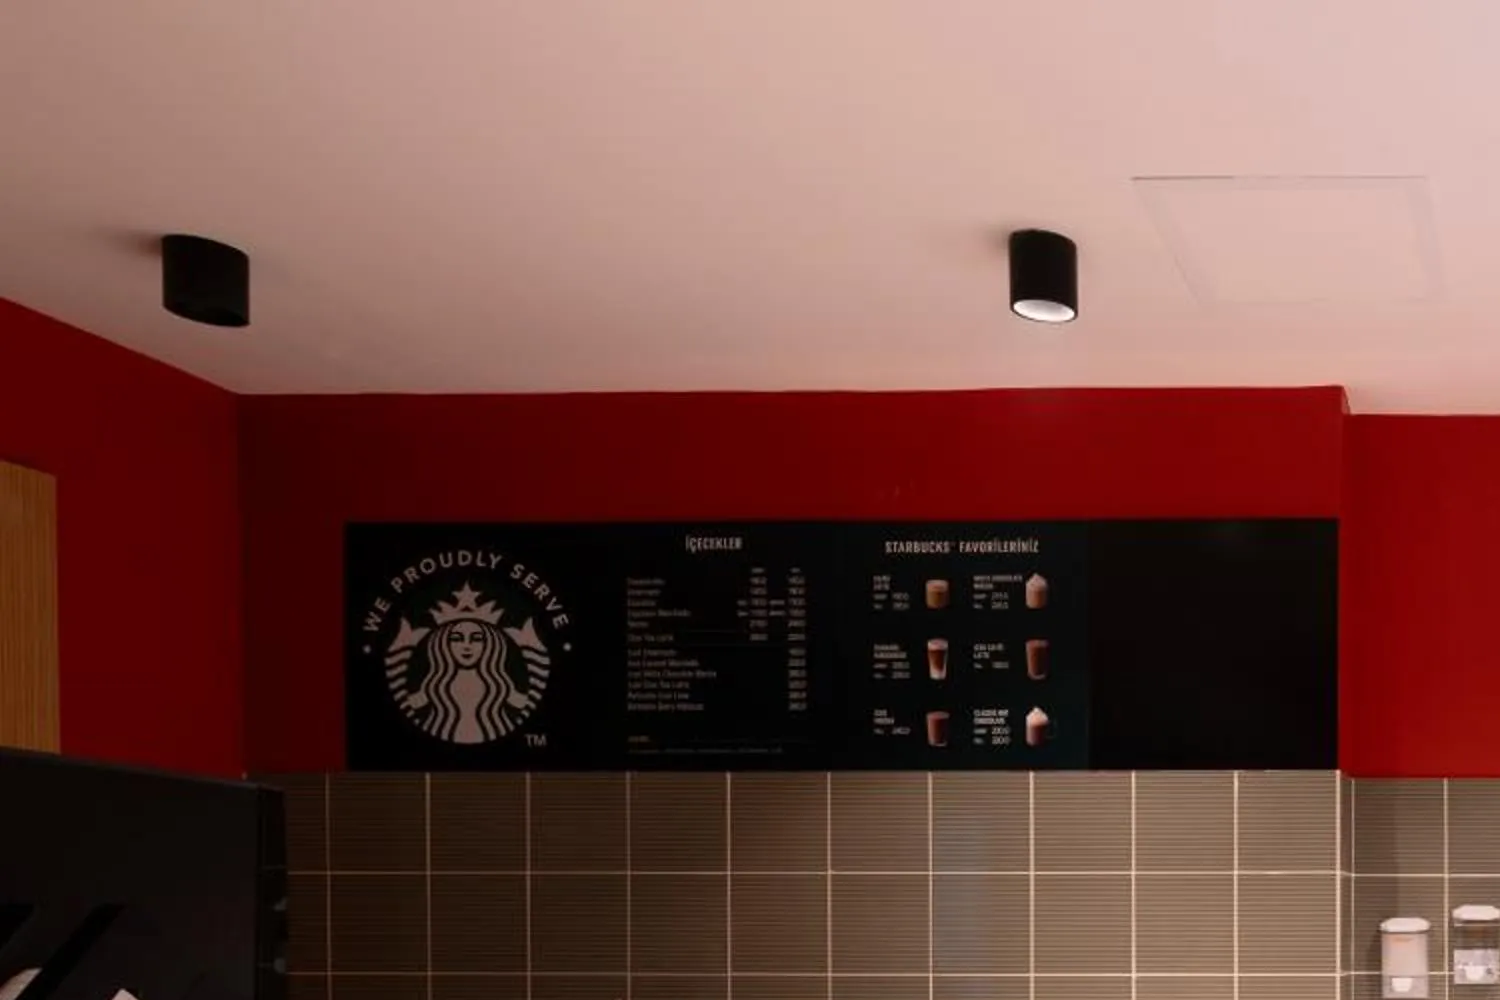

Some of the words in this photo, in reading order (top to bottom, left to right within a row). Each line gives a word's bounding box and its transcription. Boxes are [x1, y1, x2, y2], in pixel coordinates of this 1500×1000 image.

[885, 540, 951, 554] STARBUCKS
[361, 597, 392, 632] WE
[390, 549, 503, 594] PROUDLY
[509, 563, 570, 630] SERVE
